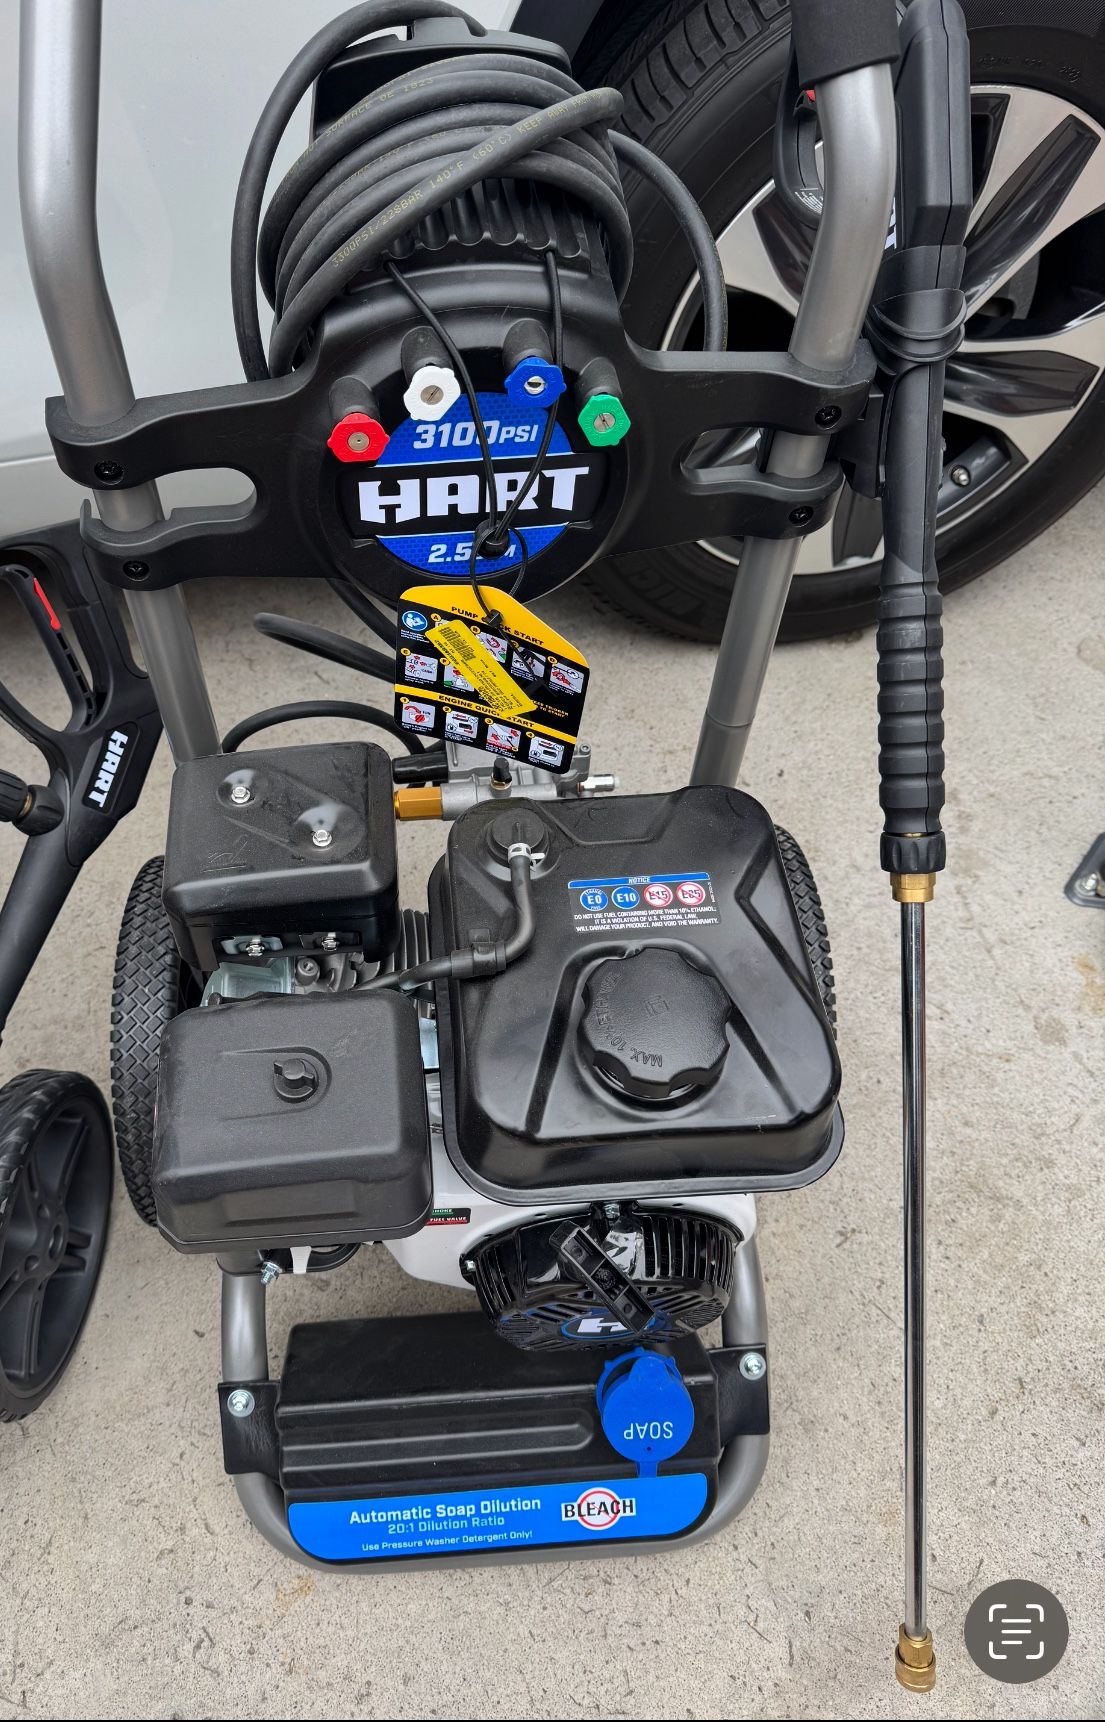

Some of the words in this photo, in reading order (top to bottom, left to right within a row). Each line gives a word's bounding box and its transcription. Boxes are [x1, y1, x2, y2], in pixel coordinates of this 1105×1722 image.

[358, 466, 590, 524] HART
[451, 606, 479, 619] PUMP
[513, 630, 545, 646] START
[438, 695, 473, 709] ENGINE
[475, 703, 501, 717] QUIC
[88, 730, 129, 808] HART
[628, 876, 650, 885] NOTICE
[587, 894, 603, 905] E0
[616, 893, 637, 903] E10
[648, 890, 668, 900] E15
[623, 1421, 673, 1440] SOAP
[350, 1505, 431, 1525] Automatic
[436, 1503, 476, 1518] Soap
[480, 1497, 541, 1515] Dilution
[564, 1499, 635, 1519] BLEACH
[388, 1522, 415, 1535] 20:1
[418, 1518, 468, 1532] Dilution
[472, 1515, 505, 1528] Ratio
[362, 1542, 380, 1551] Use
[382, 1539, 423, 1550] Pressure
[425, 1536, 460, 1547] Washer
[462, 1531, 508, 1545] Detergent
[509, 1529, 533, 1540] Only!
